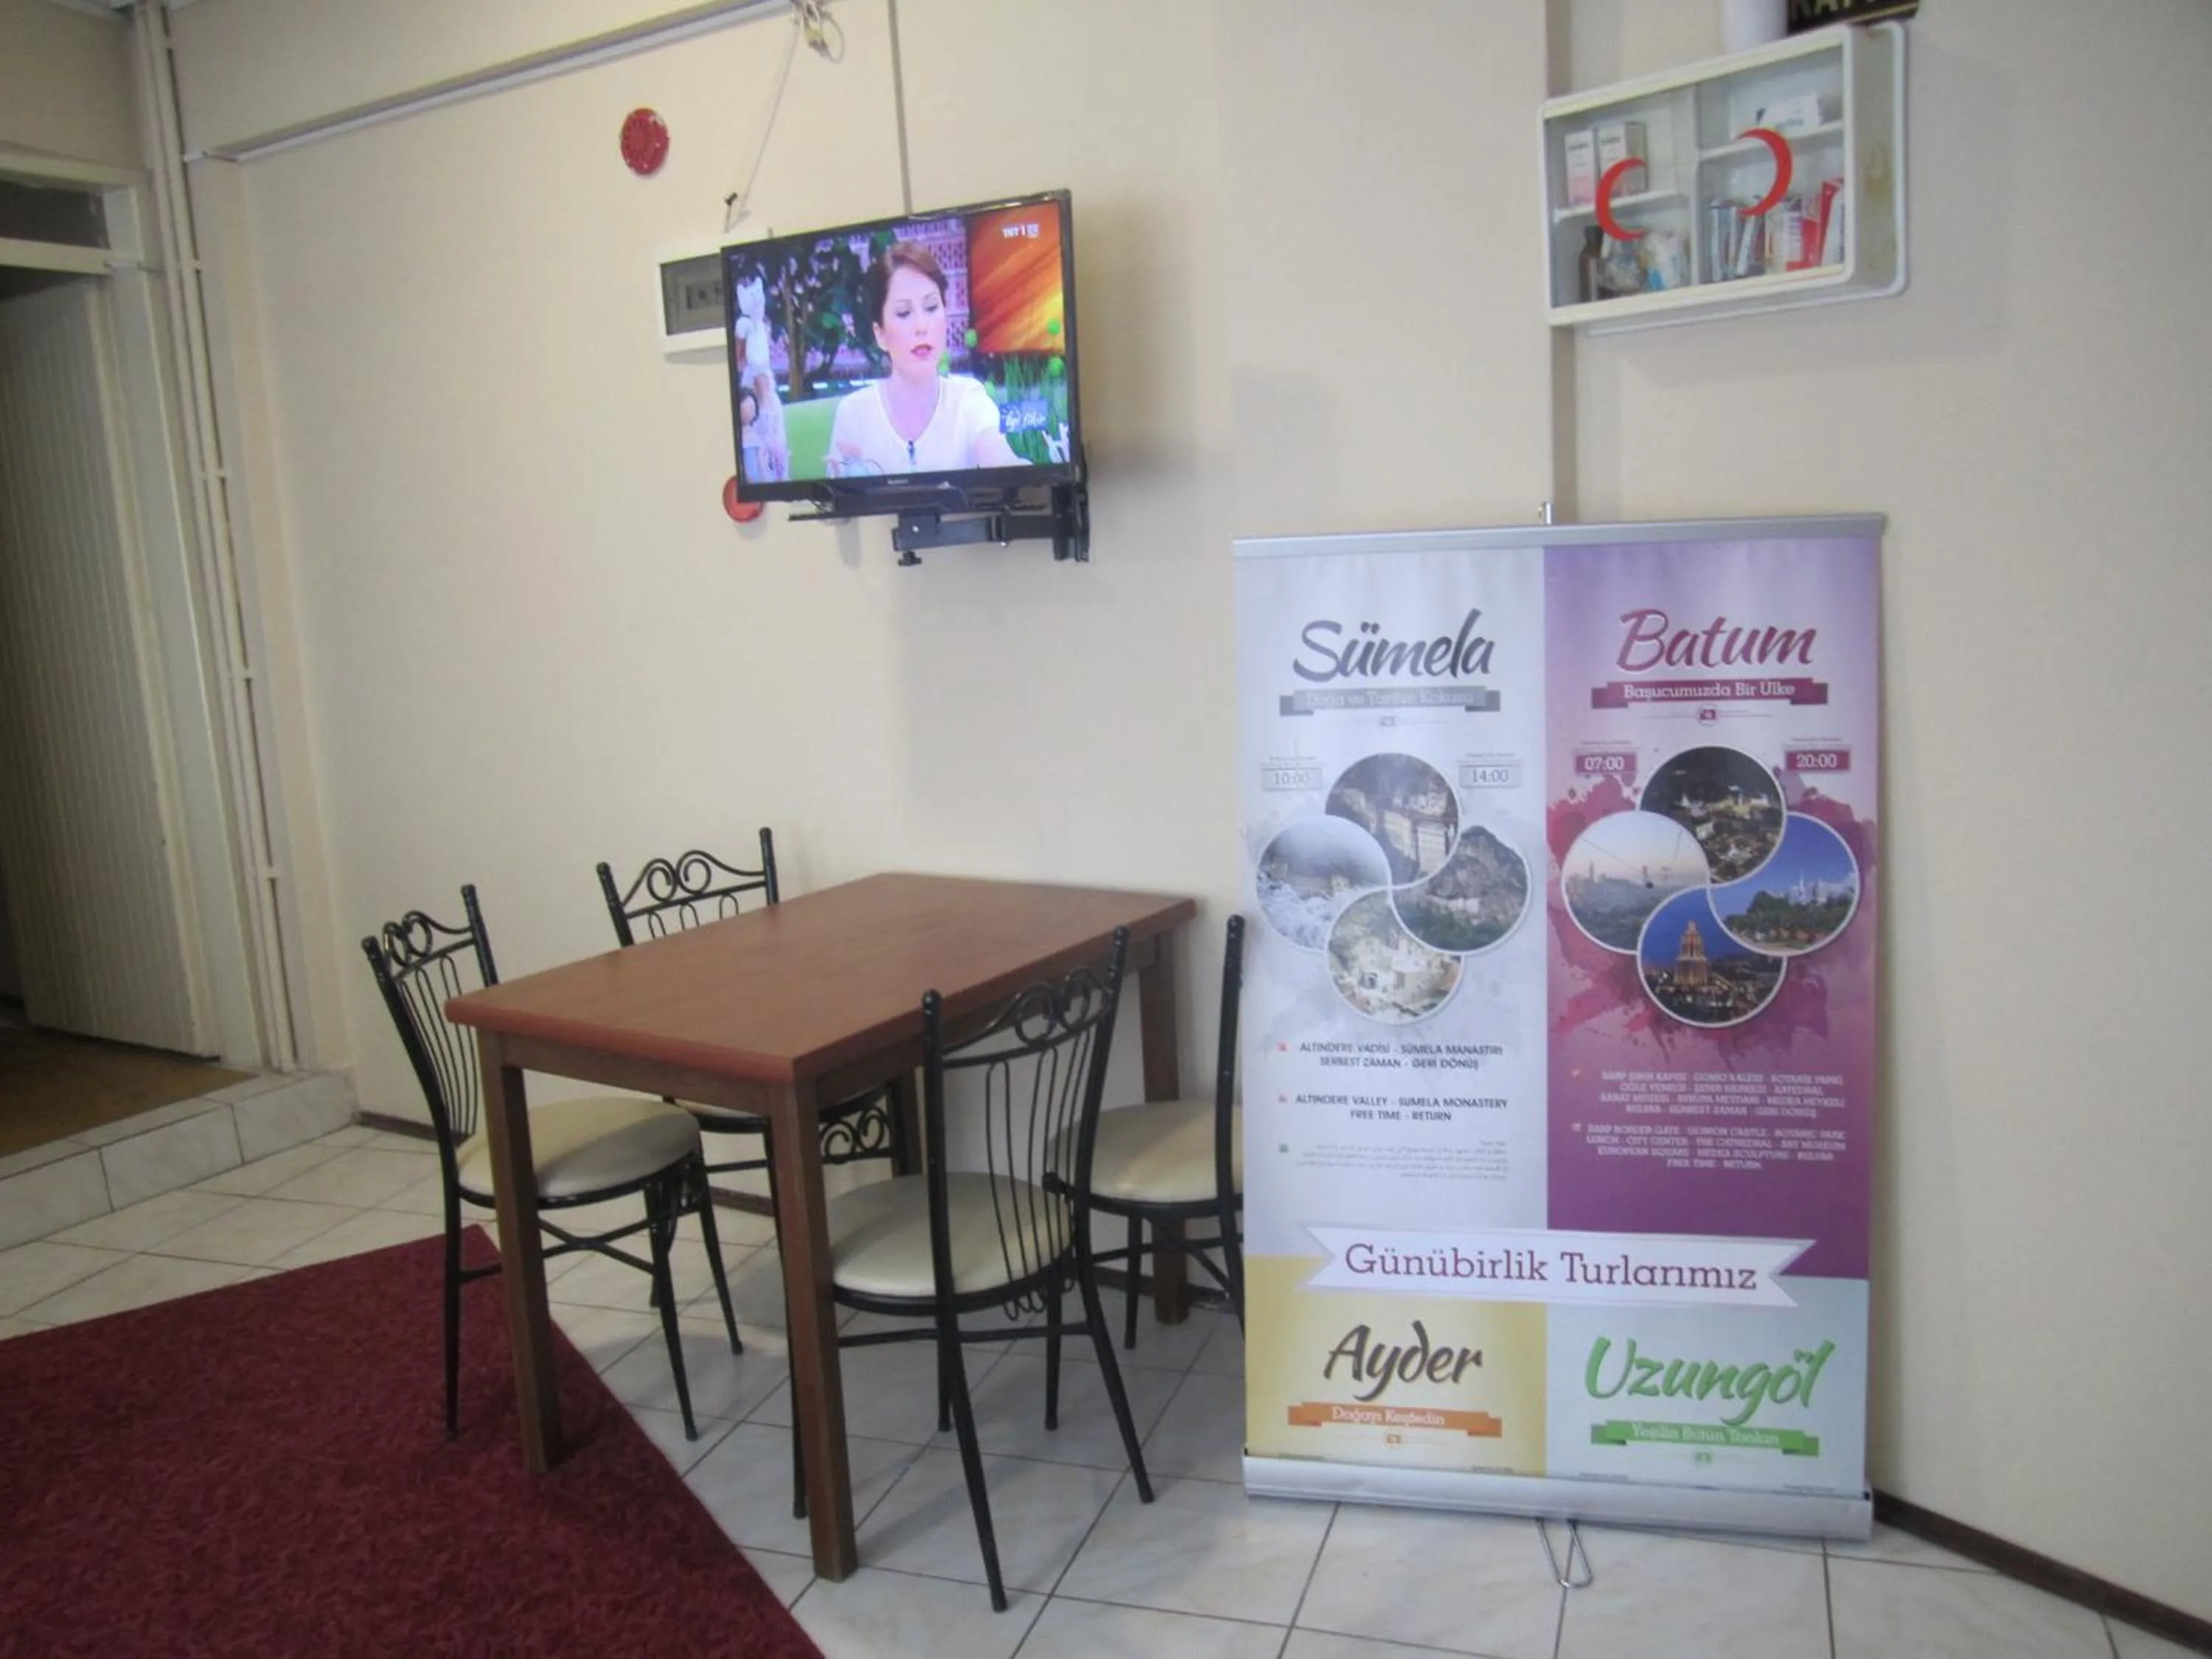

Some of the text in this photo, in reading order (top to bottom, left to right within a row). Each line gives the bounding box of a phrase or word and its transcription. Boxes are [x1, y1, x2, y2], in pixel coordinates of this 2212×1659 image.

[1293, 608, 1496, 683] Sümela
[1616, 608, 1818, 672] Batum
[1623, 682, 1732, 700] Başucumuzda
[1734, 681, 1756, 697] Bir
[1584, 757, 1624, 771] 07:00
[1795, 754, 1837, 768] 20:00
[1273, 772, 1310, 785] 10:00
[1472, 768, 1509, 783] 14:00
[1298, 1042, 1352, 1054] ALTINDERE
[1446, 1044, 1503, 1056] MANASTIRI
[1363, 1057, 1401, 1068] ZAMAN
[1295, 1093, 1349, 1105] ALTINDERE
[1352, 1096, 1388, 1107] VALLEY
[1443, 1097, 1508, 1109] MONASTERY
[1349, 1109, 1374, 1120] FREE
[1377, 1109, 1401, 1121] TIME
[1411, 1110, 1452, 1121] RETURN
[1343, 1243, 1758, 1291] Günübirlik Turlarımız
[1323, 1320, 1484, 1402] Ayder
[1585, 1336, 1836, 1427] Uzungöl
